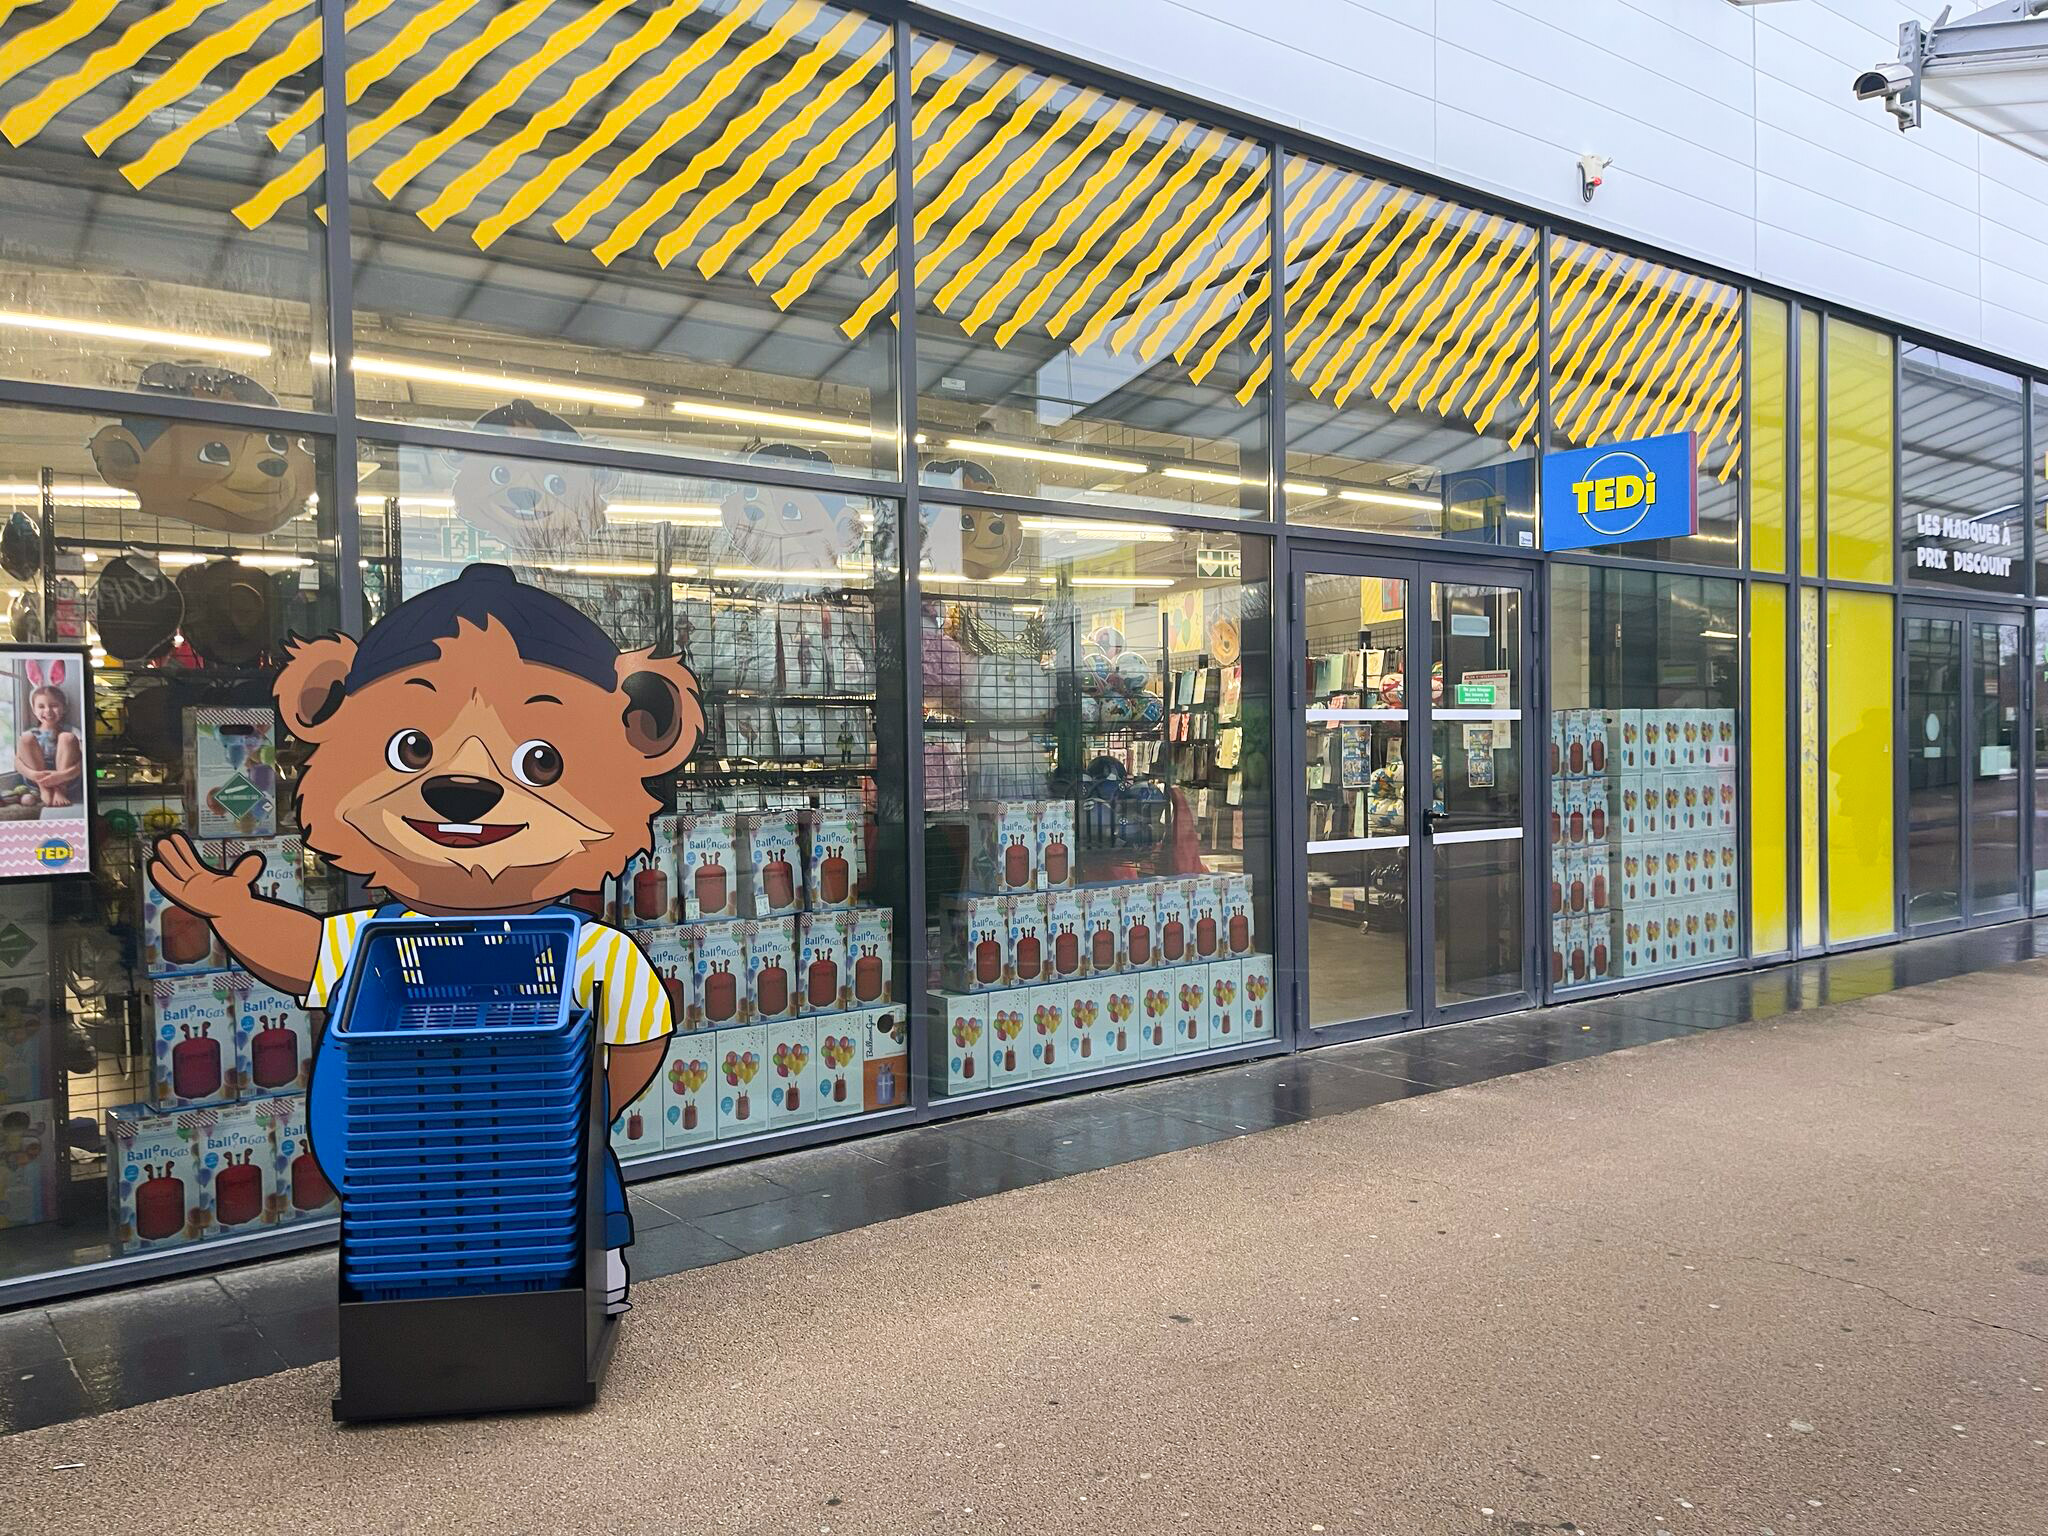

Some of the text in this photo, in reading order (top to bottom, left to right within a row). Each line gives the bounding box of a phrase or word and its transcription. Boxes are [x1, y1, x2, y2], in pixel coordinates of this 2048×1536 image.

[1572, 471, 1656, 514] TEDi
[1917, 513, 2011, 546] LES MARQUES À
[1917, 547, 2011, 577] PRIX DISCOUNT
[35, 847, 74, 861] TEDi
